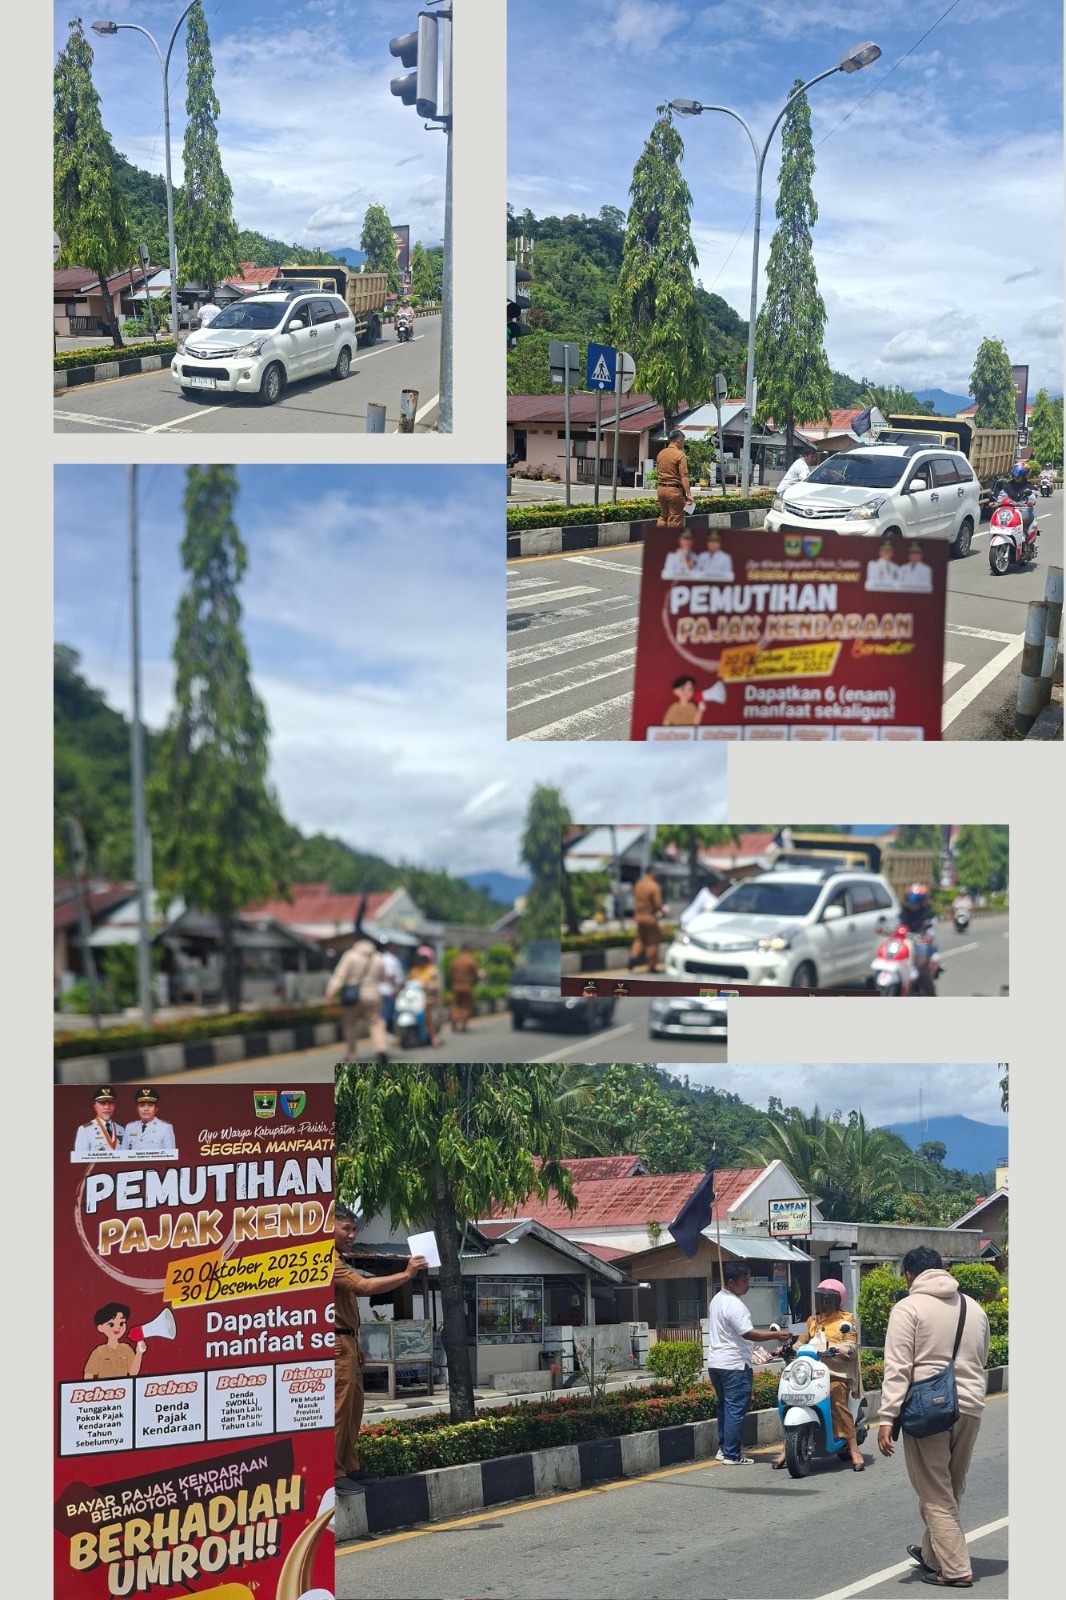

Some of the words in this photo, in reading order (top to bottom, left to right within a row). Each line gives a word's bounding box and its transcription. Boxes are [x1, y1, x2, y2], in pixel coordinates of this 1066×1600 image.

[670, 584, 838, 615] PEMUTIHAN
[676, 615, 761, 645] PAJAK
[765, 613, 914, 642] KENDARAAN
[744, 684, 822, 704] Dapatkan
[824, 685, 836, 702] 6
[838, 685, 896, 706] (enam)
[743, 701, 811, 719] manfaat
[814, 702, 896, 723] sekaligus!
[198, 1129, 218, 1144] Ayo
[220, 1127, 252, 1142] Warga
[253, 1124, 296, 1140] Kabupaten
[200, 1141, 262, 1157] SEGERA
[86, 1156, 332, 1214] PEMUTIHAN
[98, 1208, 224, 1256] PAJAK
[172, 1267, 194, 1285] 20
[199, 1257, 262, 1283] Oktober
[267, 1251, 308, 1271] 2025
[313, 1245, 335, 1266] s.d
[180, 1284, 202, 1302] 30
[205, 1271, 284, 1301] Desember
[288, 1266, 329, 1286] 2025
[206, 1305, 317, 1336] Dapatkan
[324, 1302, 335, 1323] 6
[205, 1330, 304, 1358] manfaat
[216, 1373, 267, 1390] Bebas
[281, 1367, 332, 1382] Diskon
[70, 1386, 126, 1403] Bebas
[144, 1380, 198, 1397] Bebas
[230, 1390, 254, 1399] Denda
[289, 1378, 325, 1394] 50%
[78, 1405, 122, 1414] Tunggakan
[155, 1401, 190, 1413] Denda
[225, 1398, 258, 1408] SWDKLLJ
[247, 1405, 263, 1413] Lalu
[76, 1413, 101, 1422] Pokok
[102, 1412, 124, 1421] Pajak
[157, 1412, 187, 1425] Pajak
[221, 1423, 245, 1431] Tahun
[247, 1420, 263, 1428] Lalu
[78, 1421, 122, 1431] Kendaraan
[87, 1430, 113, 1438] Tahun
[142, 1423, 202, 1436] Kendaraan
[75, 1437, 124, 1448] Sebelumnya
[66, 1494, 116, 1517] BAYAR
[121, 1480, 173, 1504] PAJAK
[178, 1456, 268, 1490] KENDARAAN
[91, 1491, 178, 1524] BERMOTOR
[183, 1488, 189, 1501] 1
[193, 1475, 244, 1498] TAHUN
[69, 1474, 302, 1571] BERHADIAH
[107, 1518, 278, 1597] UMROH!!
